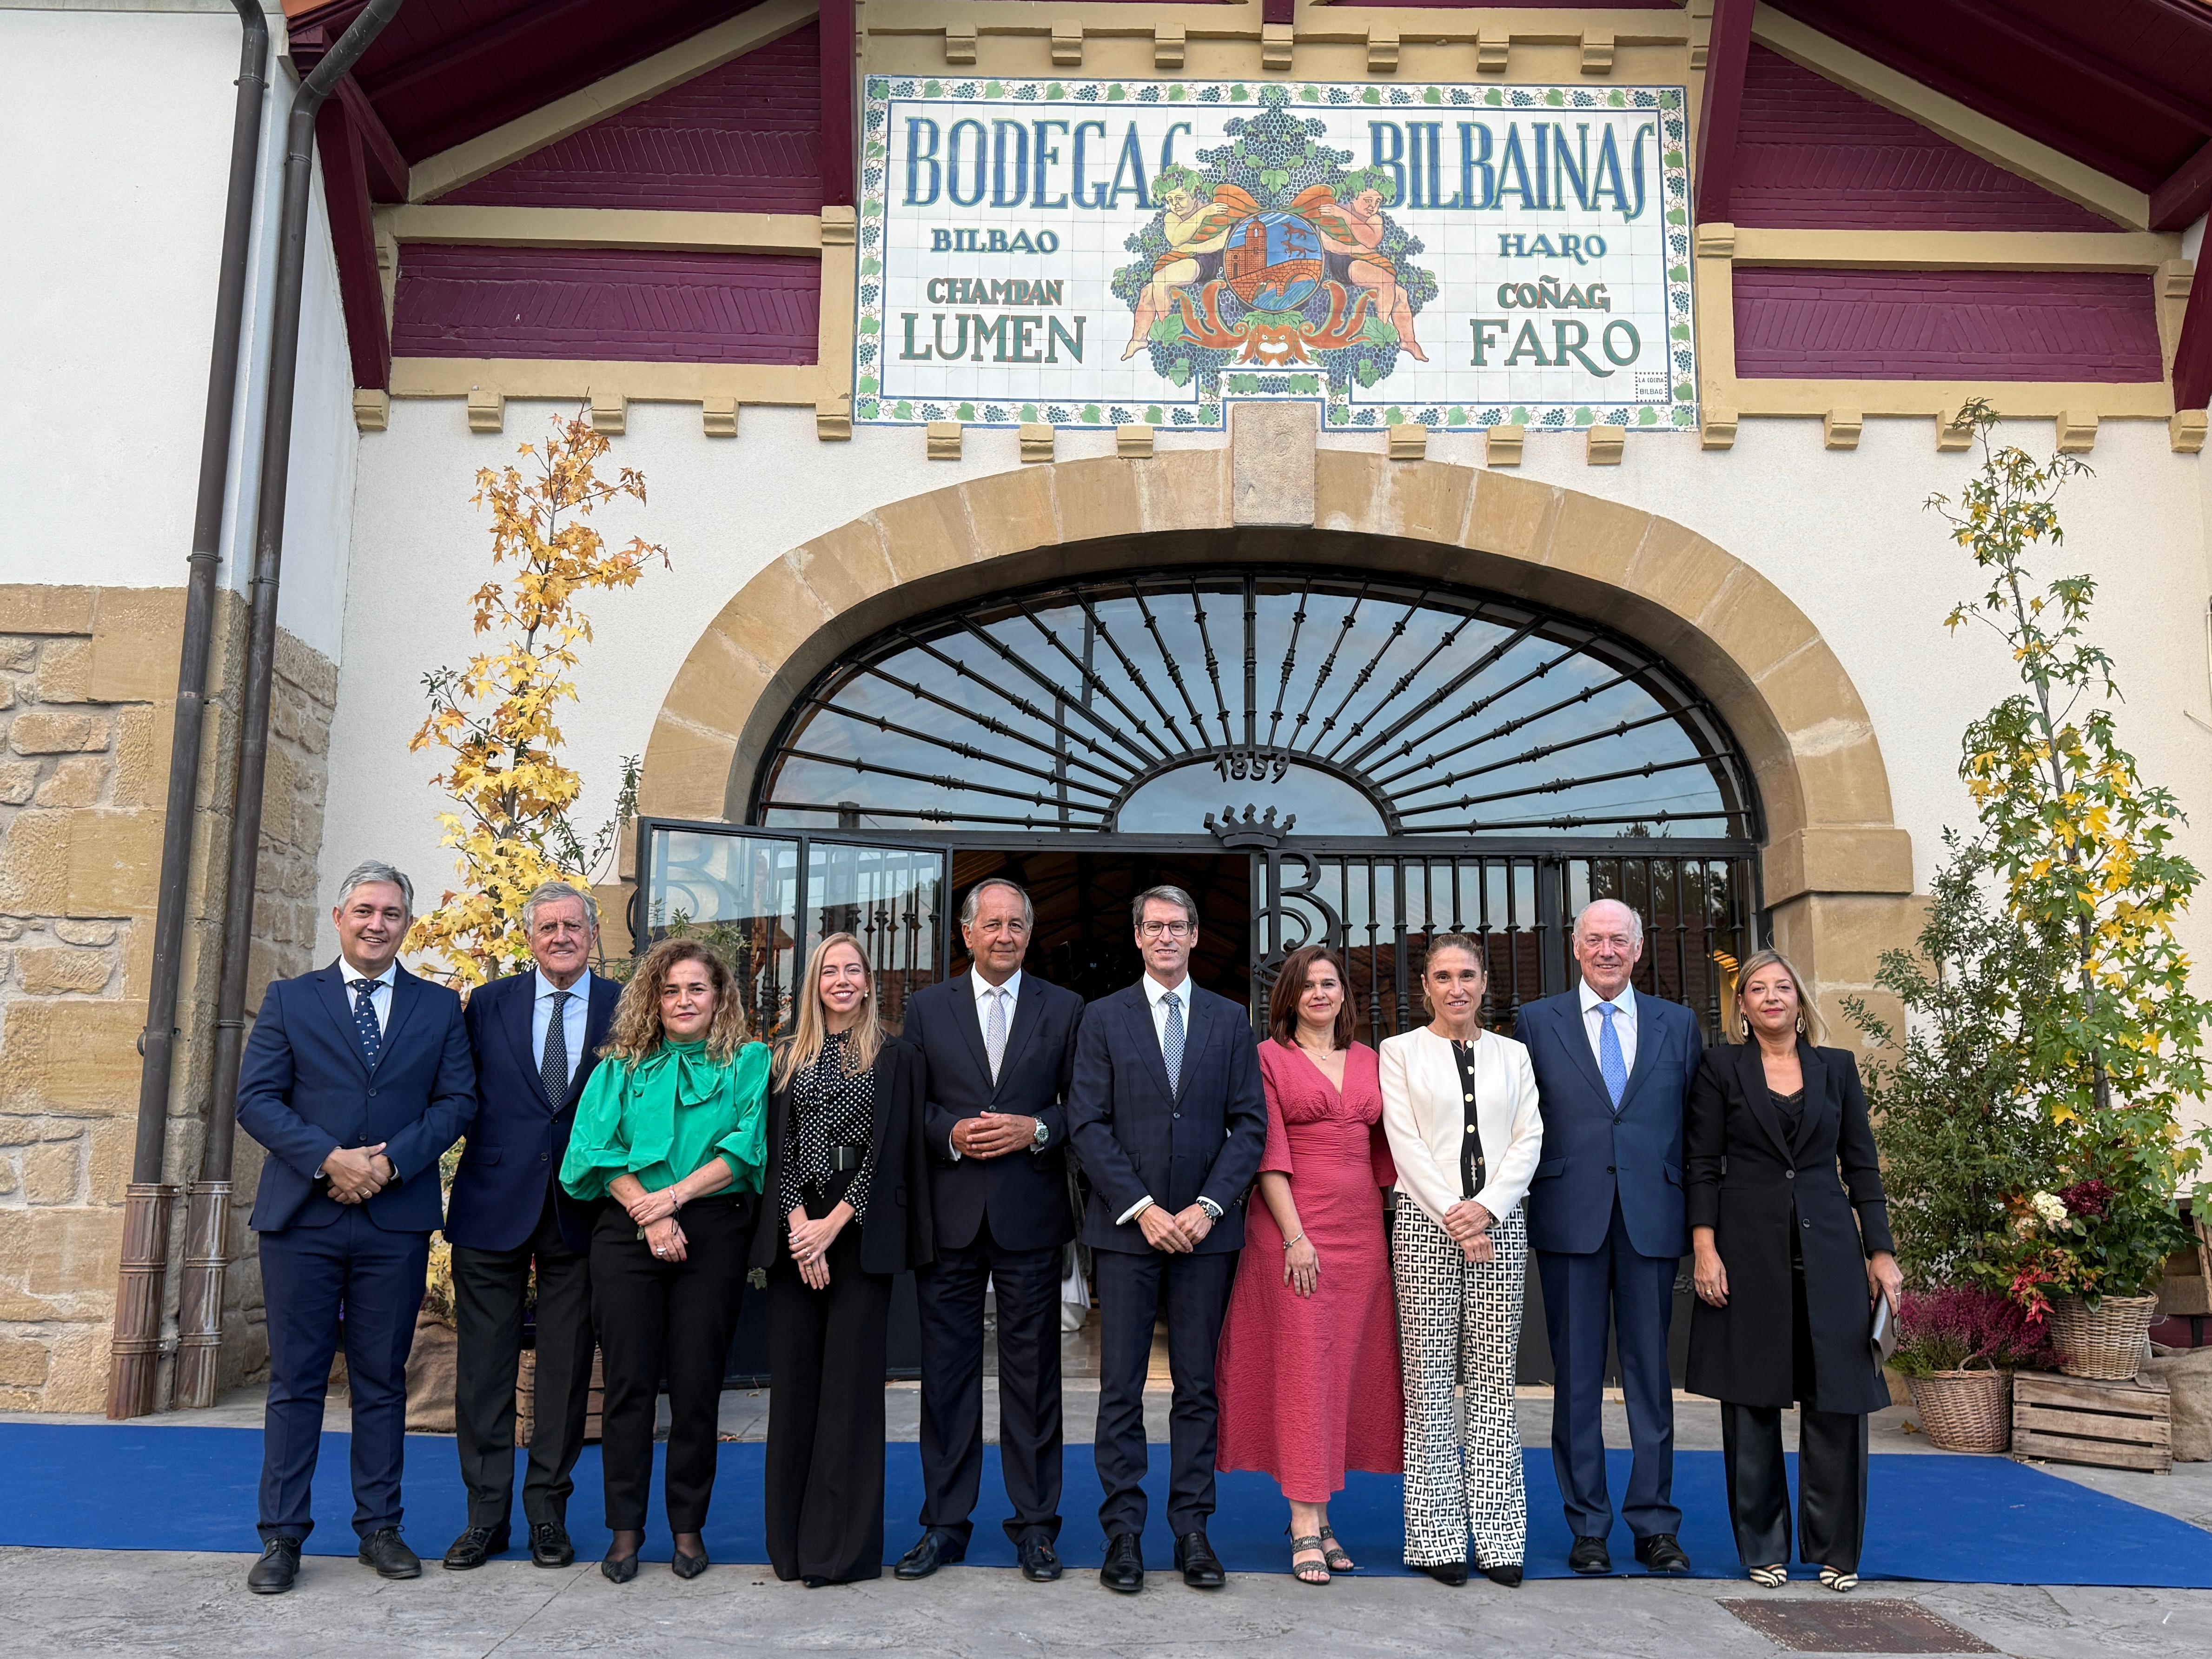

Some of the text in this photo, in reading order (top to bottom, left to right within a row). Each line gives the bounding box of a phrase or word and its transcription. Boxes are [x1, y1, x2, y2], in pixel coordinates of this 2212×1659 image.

[1368, 120, 1655, 222] BILBAINAS
[931, 228, 1060, 254] BILBAO
[1498, 233, 1607, 265] HARO
[900, 313, 1086, 364] LUMEN
[1470, 319, 1641, 377] FARO
[1214, 750, 1291, 776] 1859
